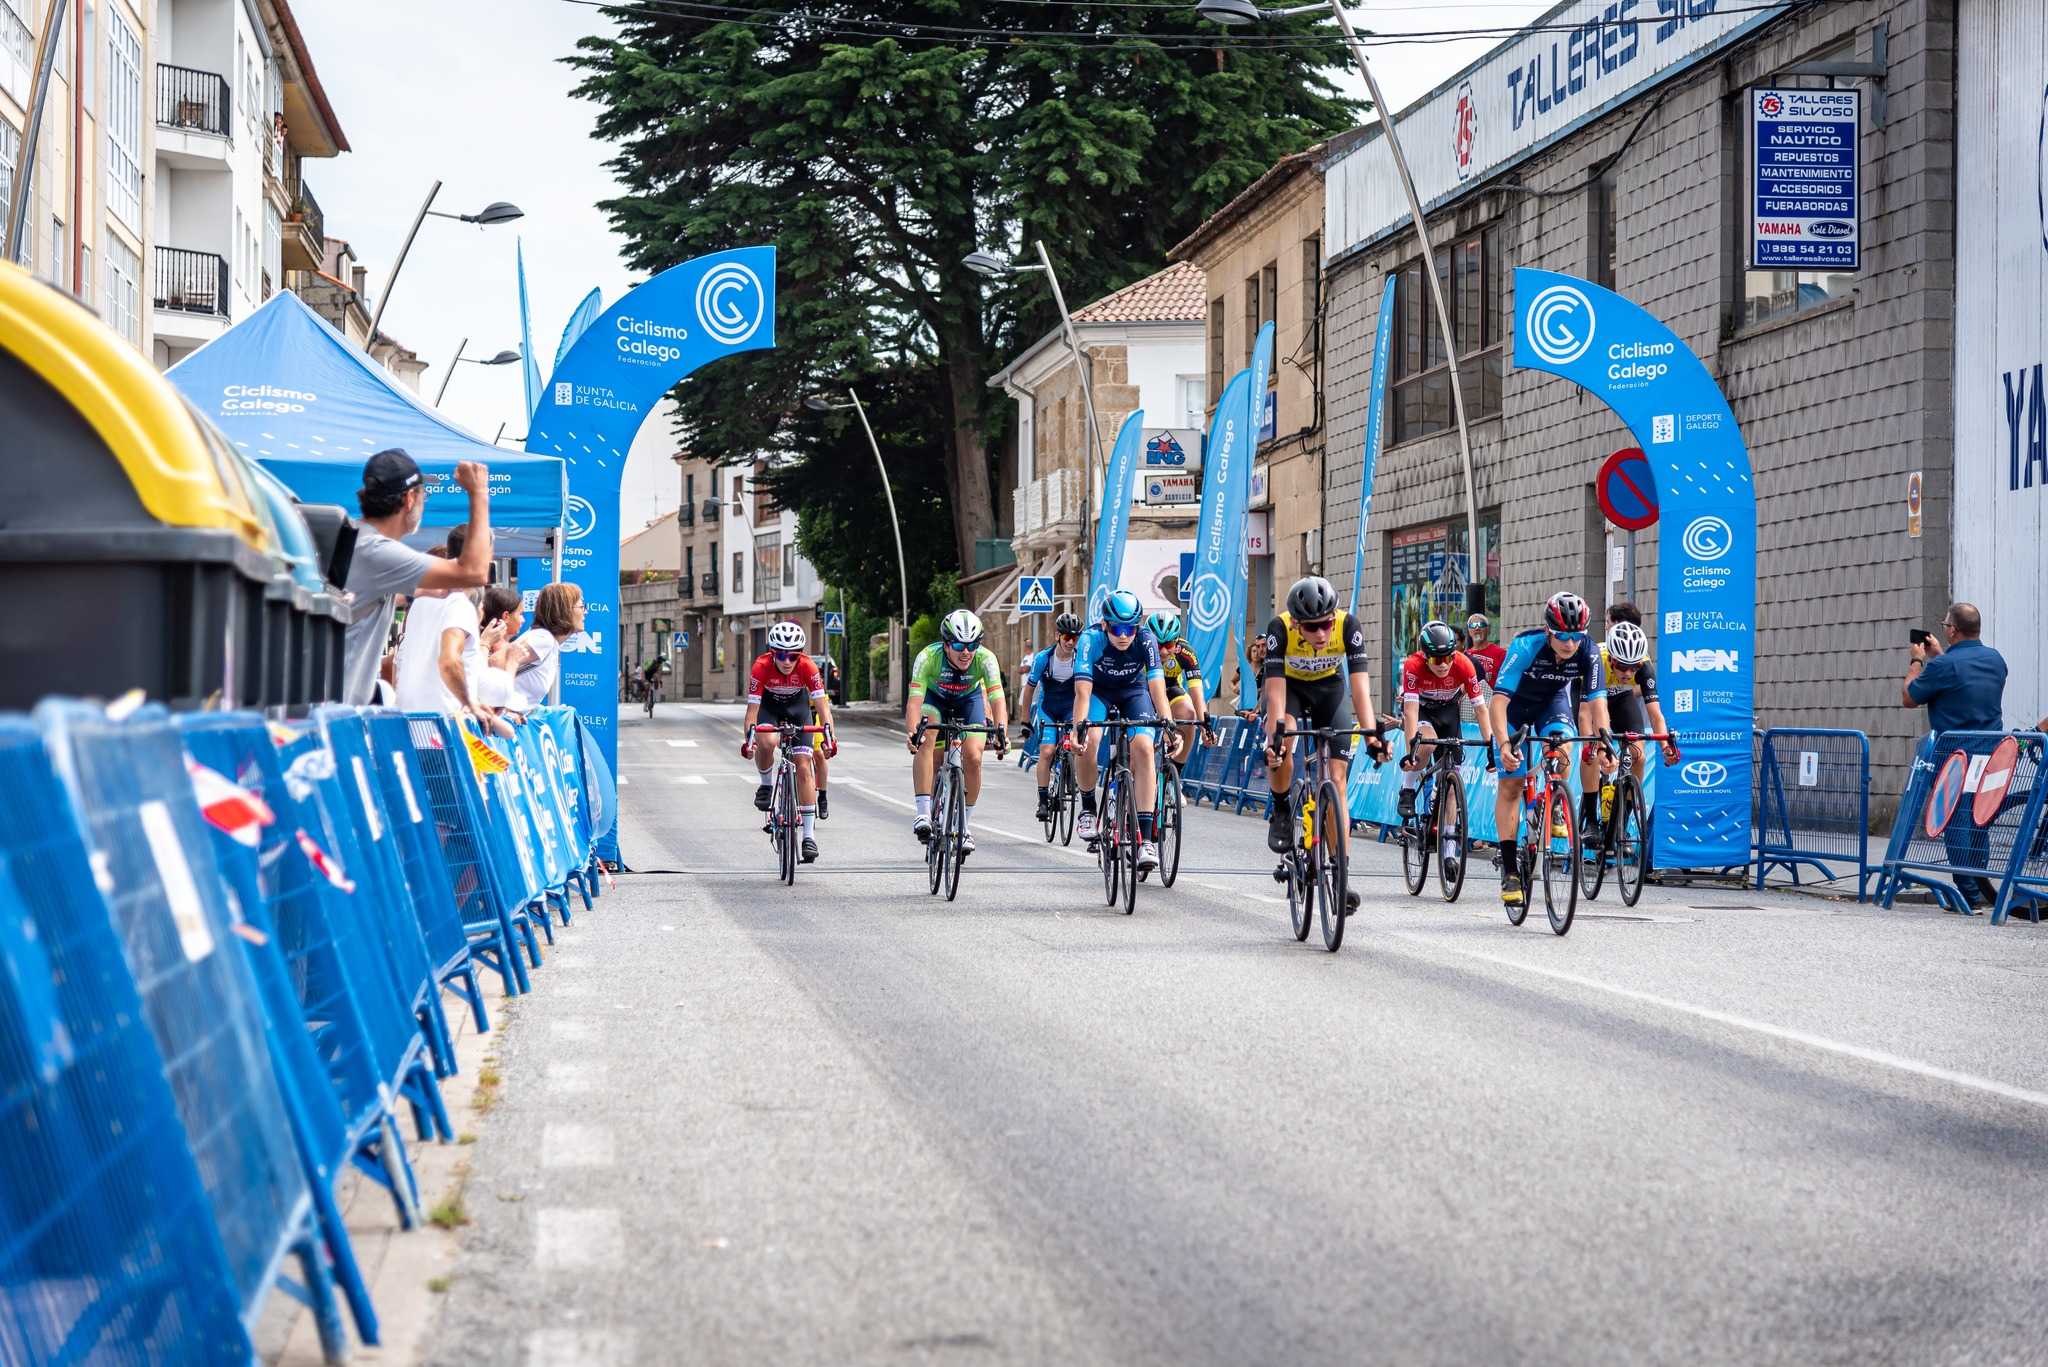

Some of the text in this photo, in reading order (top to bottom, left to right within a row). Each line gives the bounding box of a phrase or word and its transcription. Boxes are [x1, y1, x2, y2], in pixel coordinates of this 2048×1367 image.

[1788, 95, 1853, 105] TALLERES
[1788, 106, 1854, 117] SILVOSO
[1777, 125, 1835, 134] SERVICIO
[1770, 135, 1841, 145] NAUTICO
[1774, 152, 1840, 163] REPUESTOS
[1761, 167, 1853, 179] MANTENIMIENTO
[1771, 184, 1842, 194] ACCESORIOS
[1765, 201, 1848, 212] FUERABORDAS
[1757, 222, 1802, 236] YAMAHA
[1827, 224, 1851, 235] Diesel
[1772, 244, 1852, 254] 986 54 21 03
[616, 315, 688, 340] Ciclismo
[616, 335, 681, 361] Galego
[1608, 341, 1675, 360] Ciclismo
[1608, 362, 1668, 381] Galego
[223, 384, 317, 401] Ciclismo
[576, 384, 614, 399] XUNTA
[222, 398, 305, 413] Galego
[576, 395, 638, 412] DE GALICIA
[1686, 413, 1723, 423] DEPORTE
[1686, 421, 1720, 431] GALEGO
[1162, 478, 1194, 487] YAMAHA
[1207, 492, 1225, 565] Ciclismo
[1216, 419, 1235, 484] Galego
[1683, 566, 1731, 577] Ciclismo
[1683, 577, 1726, 588] Galego
[1686, 611, 1724, 621] XUNTA
[1685, 621, 1747, 631] DE GALICIA
[565, 672, 598, 681] DEPORTE
[565, 679, 596, 687] GALEGO
[1702, 690, 1735, 698] DEPORTE
[1702, 697, 1732, 705] GALEGO
